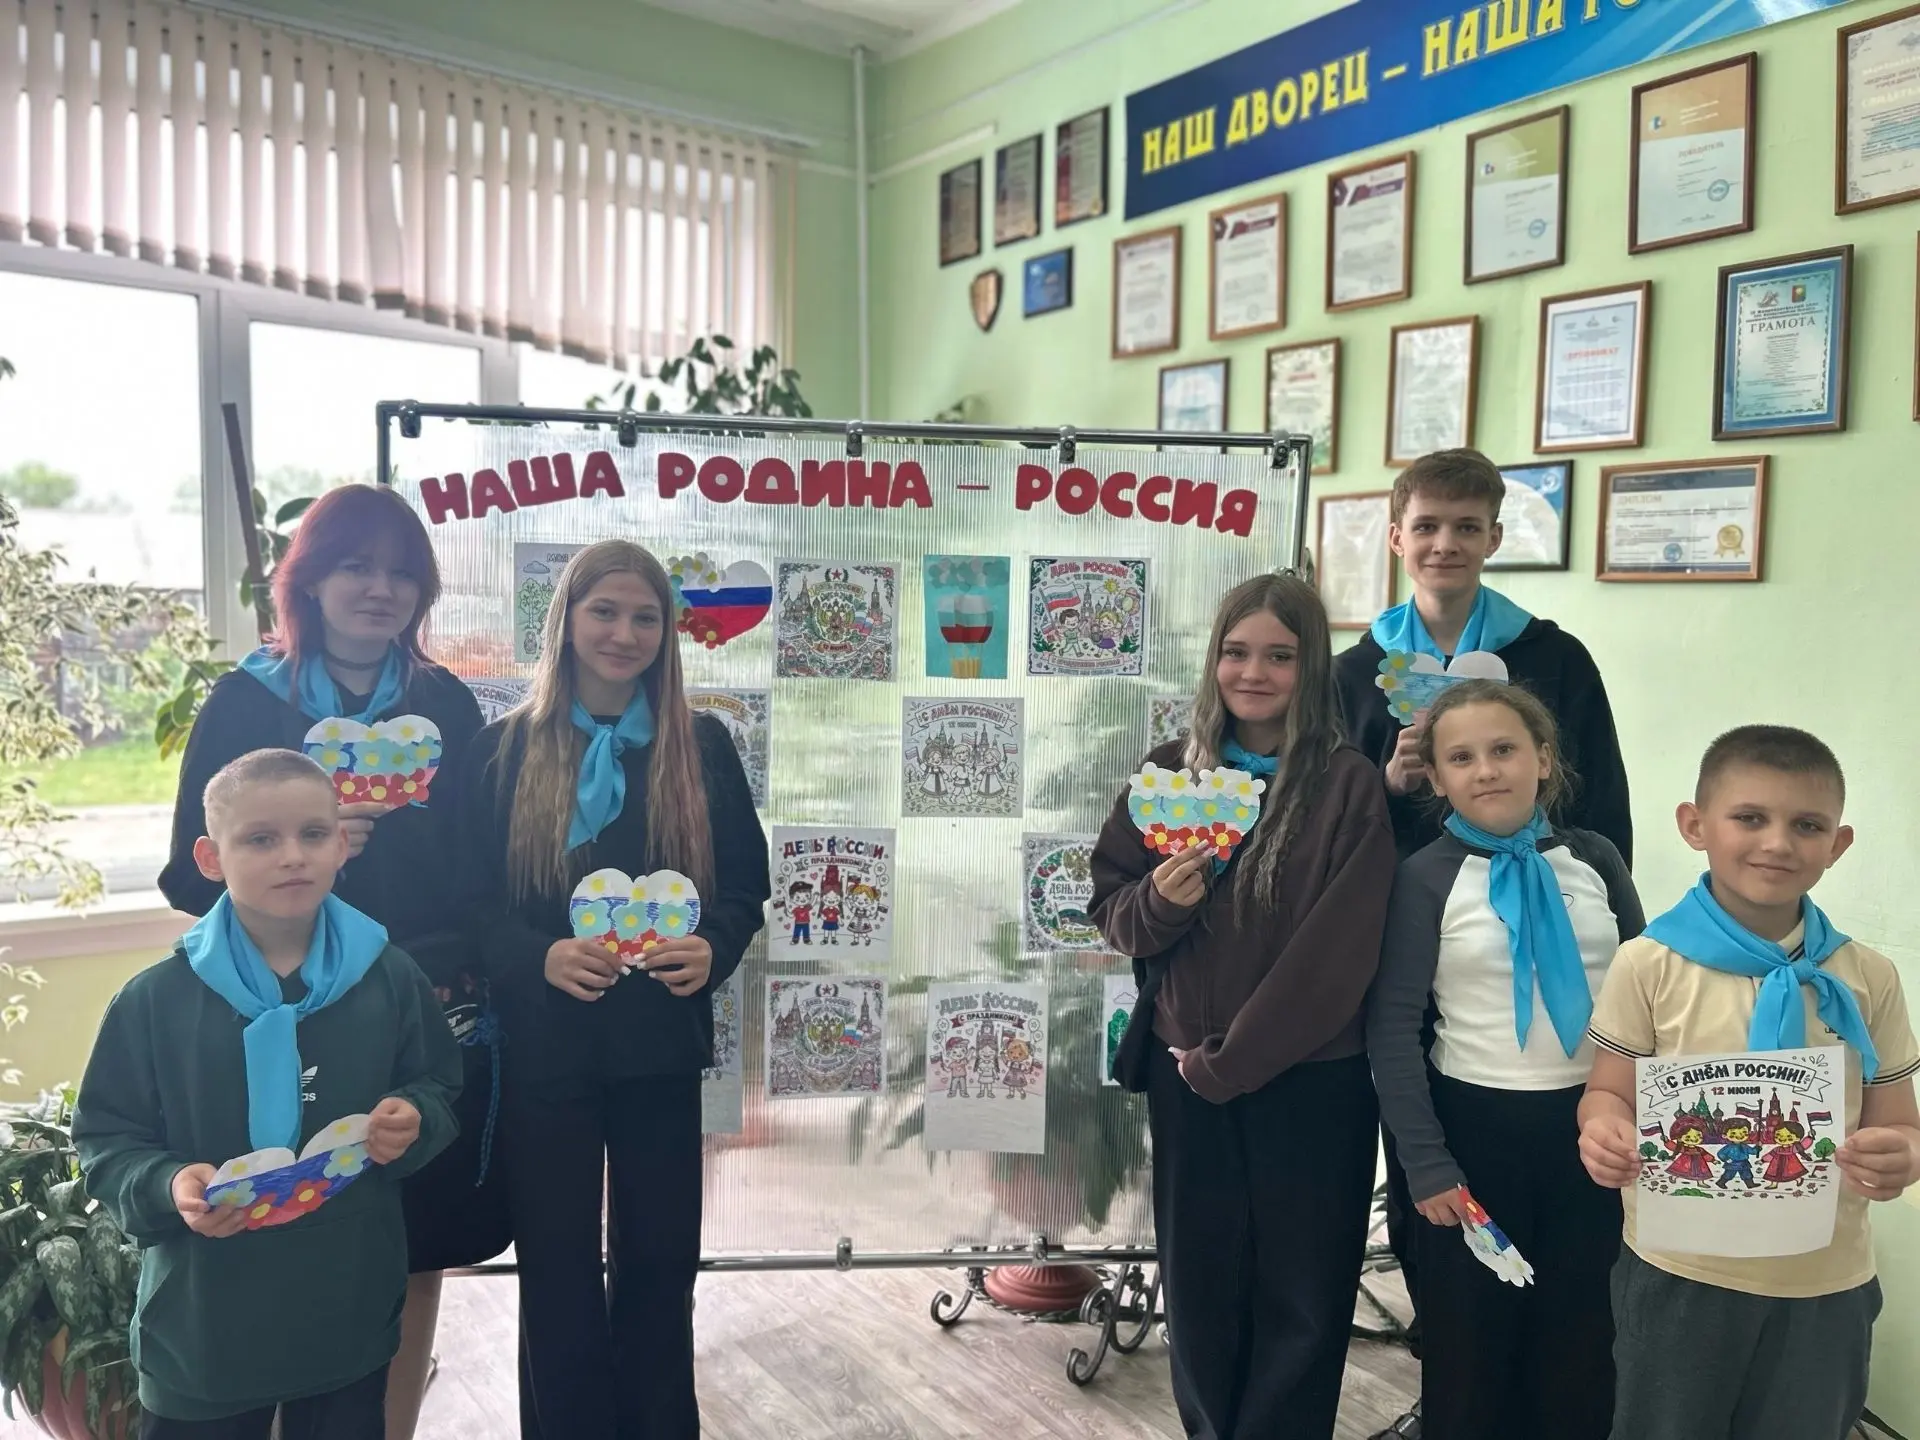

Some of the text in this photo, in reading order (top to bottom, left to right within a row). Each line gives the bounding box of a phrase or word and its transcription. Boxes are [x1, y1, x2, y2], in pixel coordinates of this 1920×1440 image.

[1142, 106, 1217, 174] НАШ
[1226, 48, 1369, 146] ДВОРЕЦ
[1421, 0, 1564, 77] НАША
[1750, 316, 1816, 333] ГРАМОТА
[419, 451, 625, 525] НАША
[657, 452, 933, 509] РОДИНА
[1015, 464, 1258, 537] РОССИЯ
[1050, 562, 1129, 579] ДЕНЬ РОССИИ
[474, 686, 516, 706] ОССИИ!
[921, 711, 929, 722] С
[931, 703, 959, 720] ДНЁМ
[783, 839, 885, 860] ДЕНЬ РОССИИ
[1049, 883, 1095, 895] ДЕНЬ РОСС
[940, 994, 1039, 1016] ДЕНЬ РОССИИ
[959, 1012, 1018, 1022] С ПРАЗДНИКОМ!
[1666, 1063, 1806, 1088] С ДНЁМ РОССИИ!
[1711, 1086, 1761, 1096] 12 ИЮНЯ
